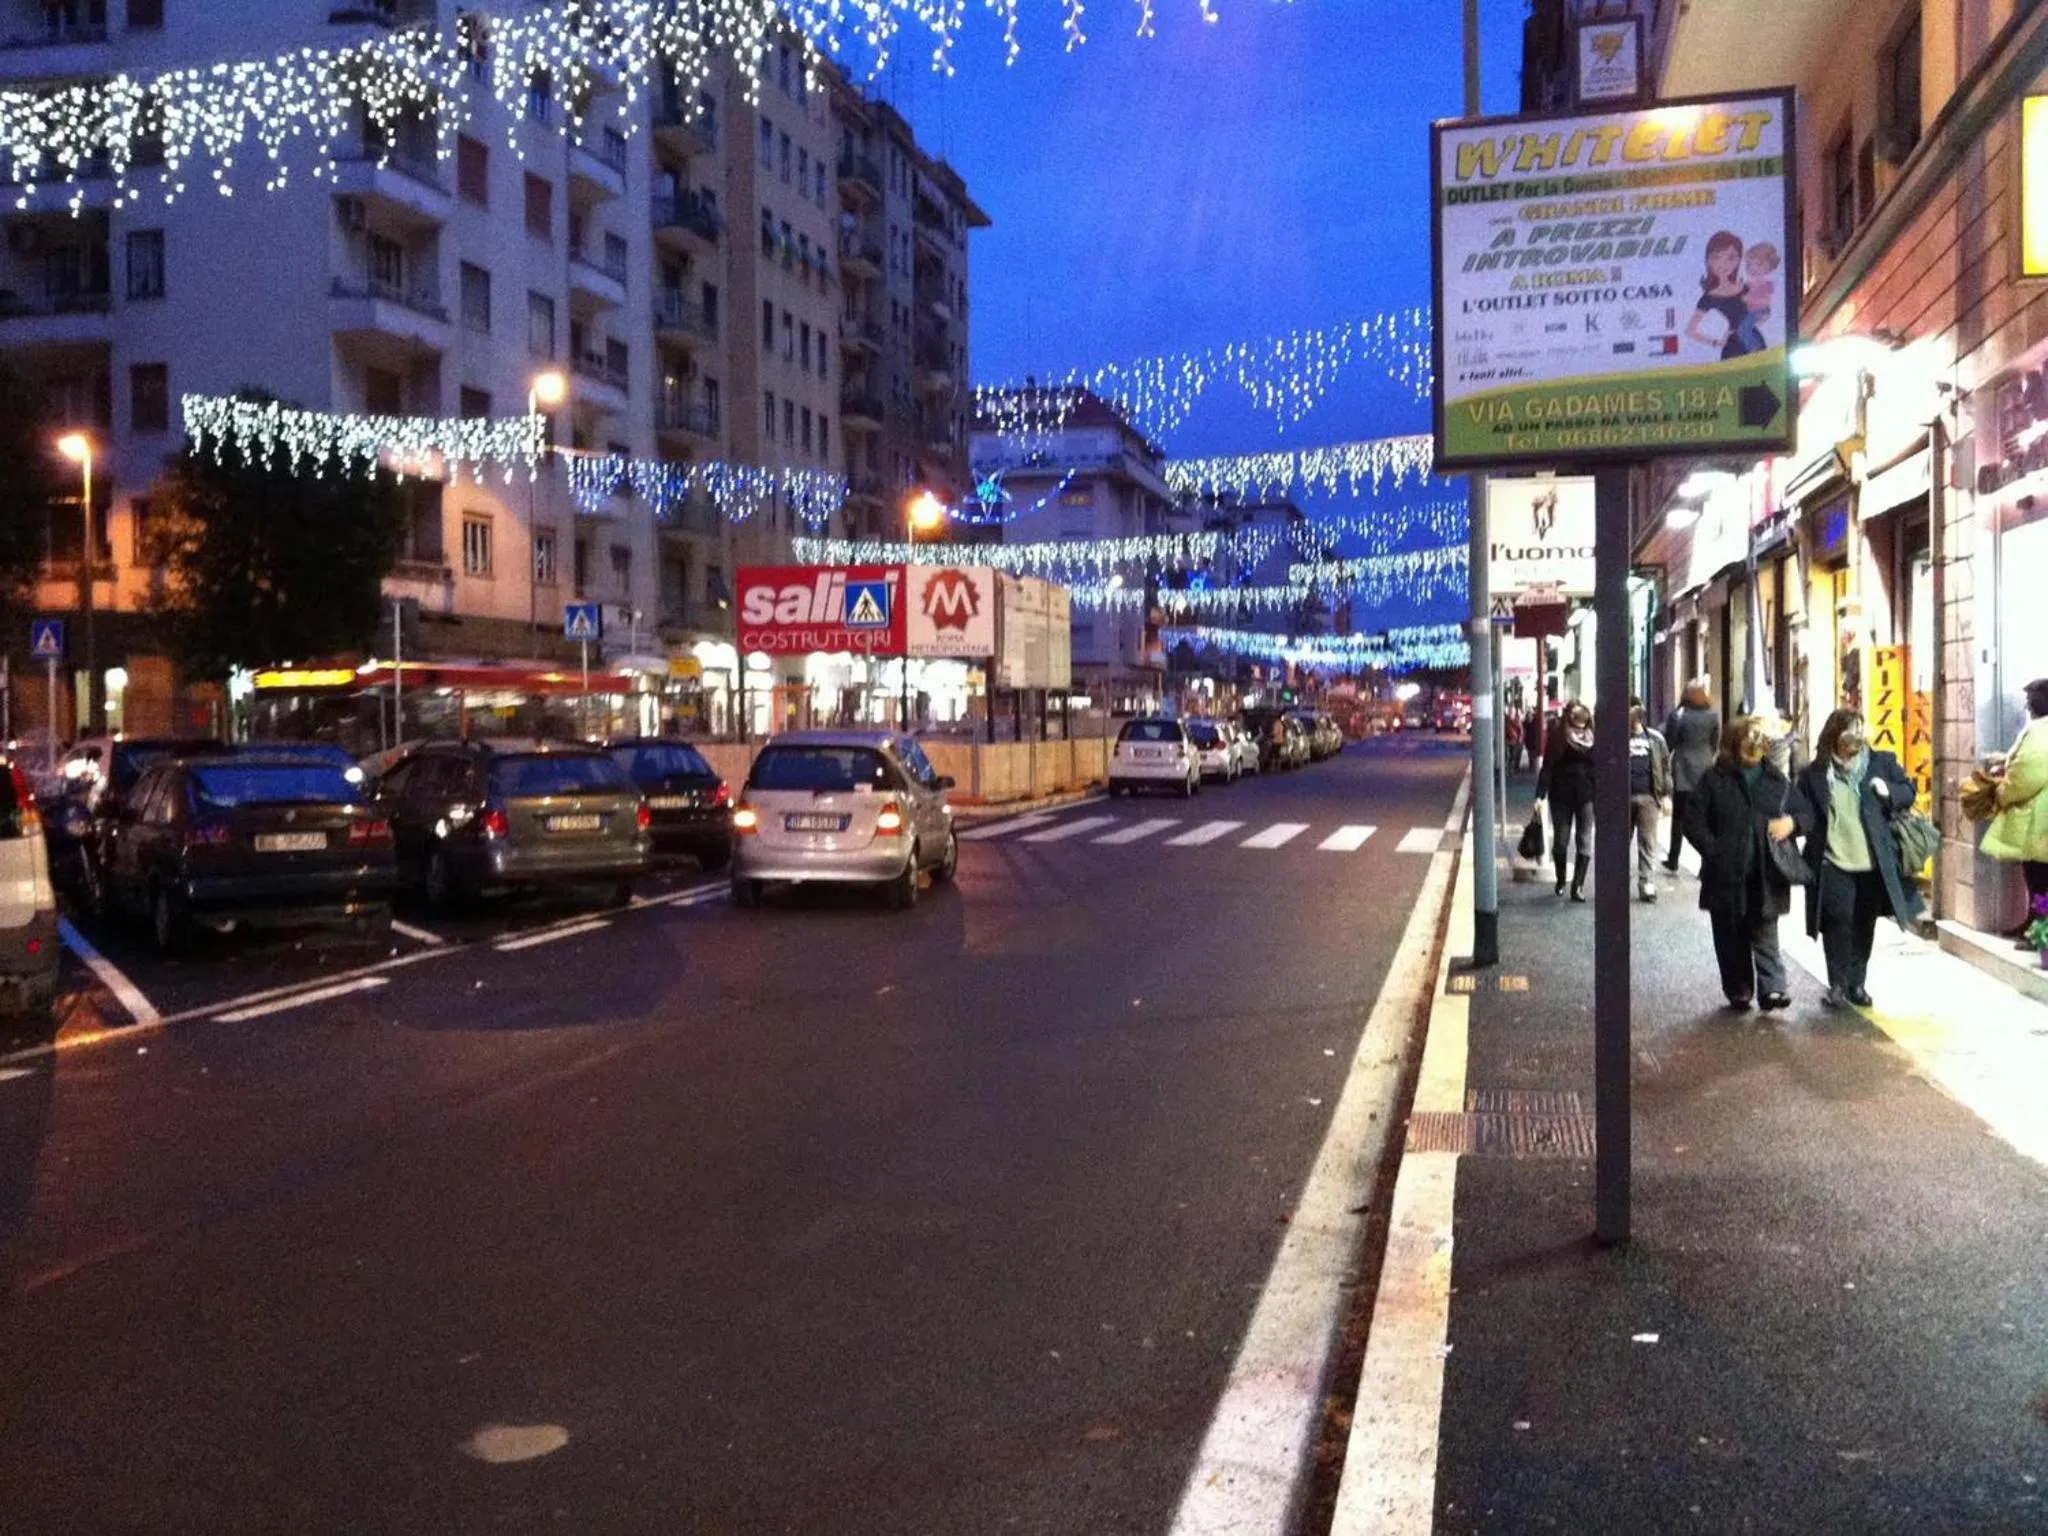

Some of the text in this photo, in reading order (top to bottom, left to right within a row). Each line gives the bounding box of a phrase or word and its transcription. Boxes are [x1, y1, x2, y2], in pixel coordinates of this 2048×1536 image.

[1447, 181, 1509, 206] OUTLET
[1515, 180, 1539, 199] Per
[1491, 215, 1656, 249] A PREZZI
[1462, 235, 1689, 273] INTROVABILI
[1463, 284, 1673, 313] L'OUTLET SOTTO CASA
[1470, 385, 1734, 423] VIA GADAMES 18 A
[1518, 421, 1540, 432] UN
[1626, 412, 1673, 425] VIALE
[743, 629, 891, 649] COSTRUTTORI
[1873, 650, 1896, 746] PIZZA
